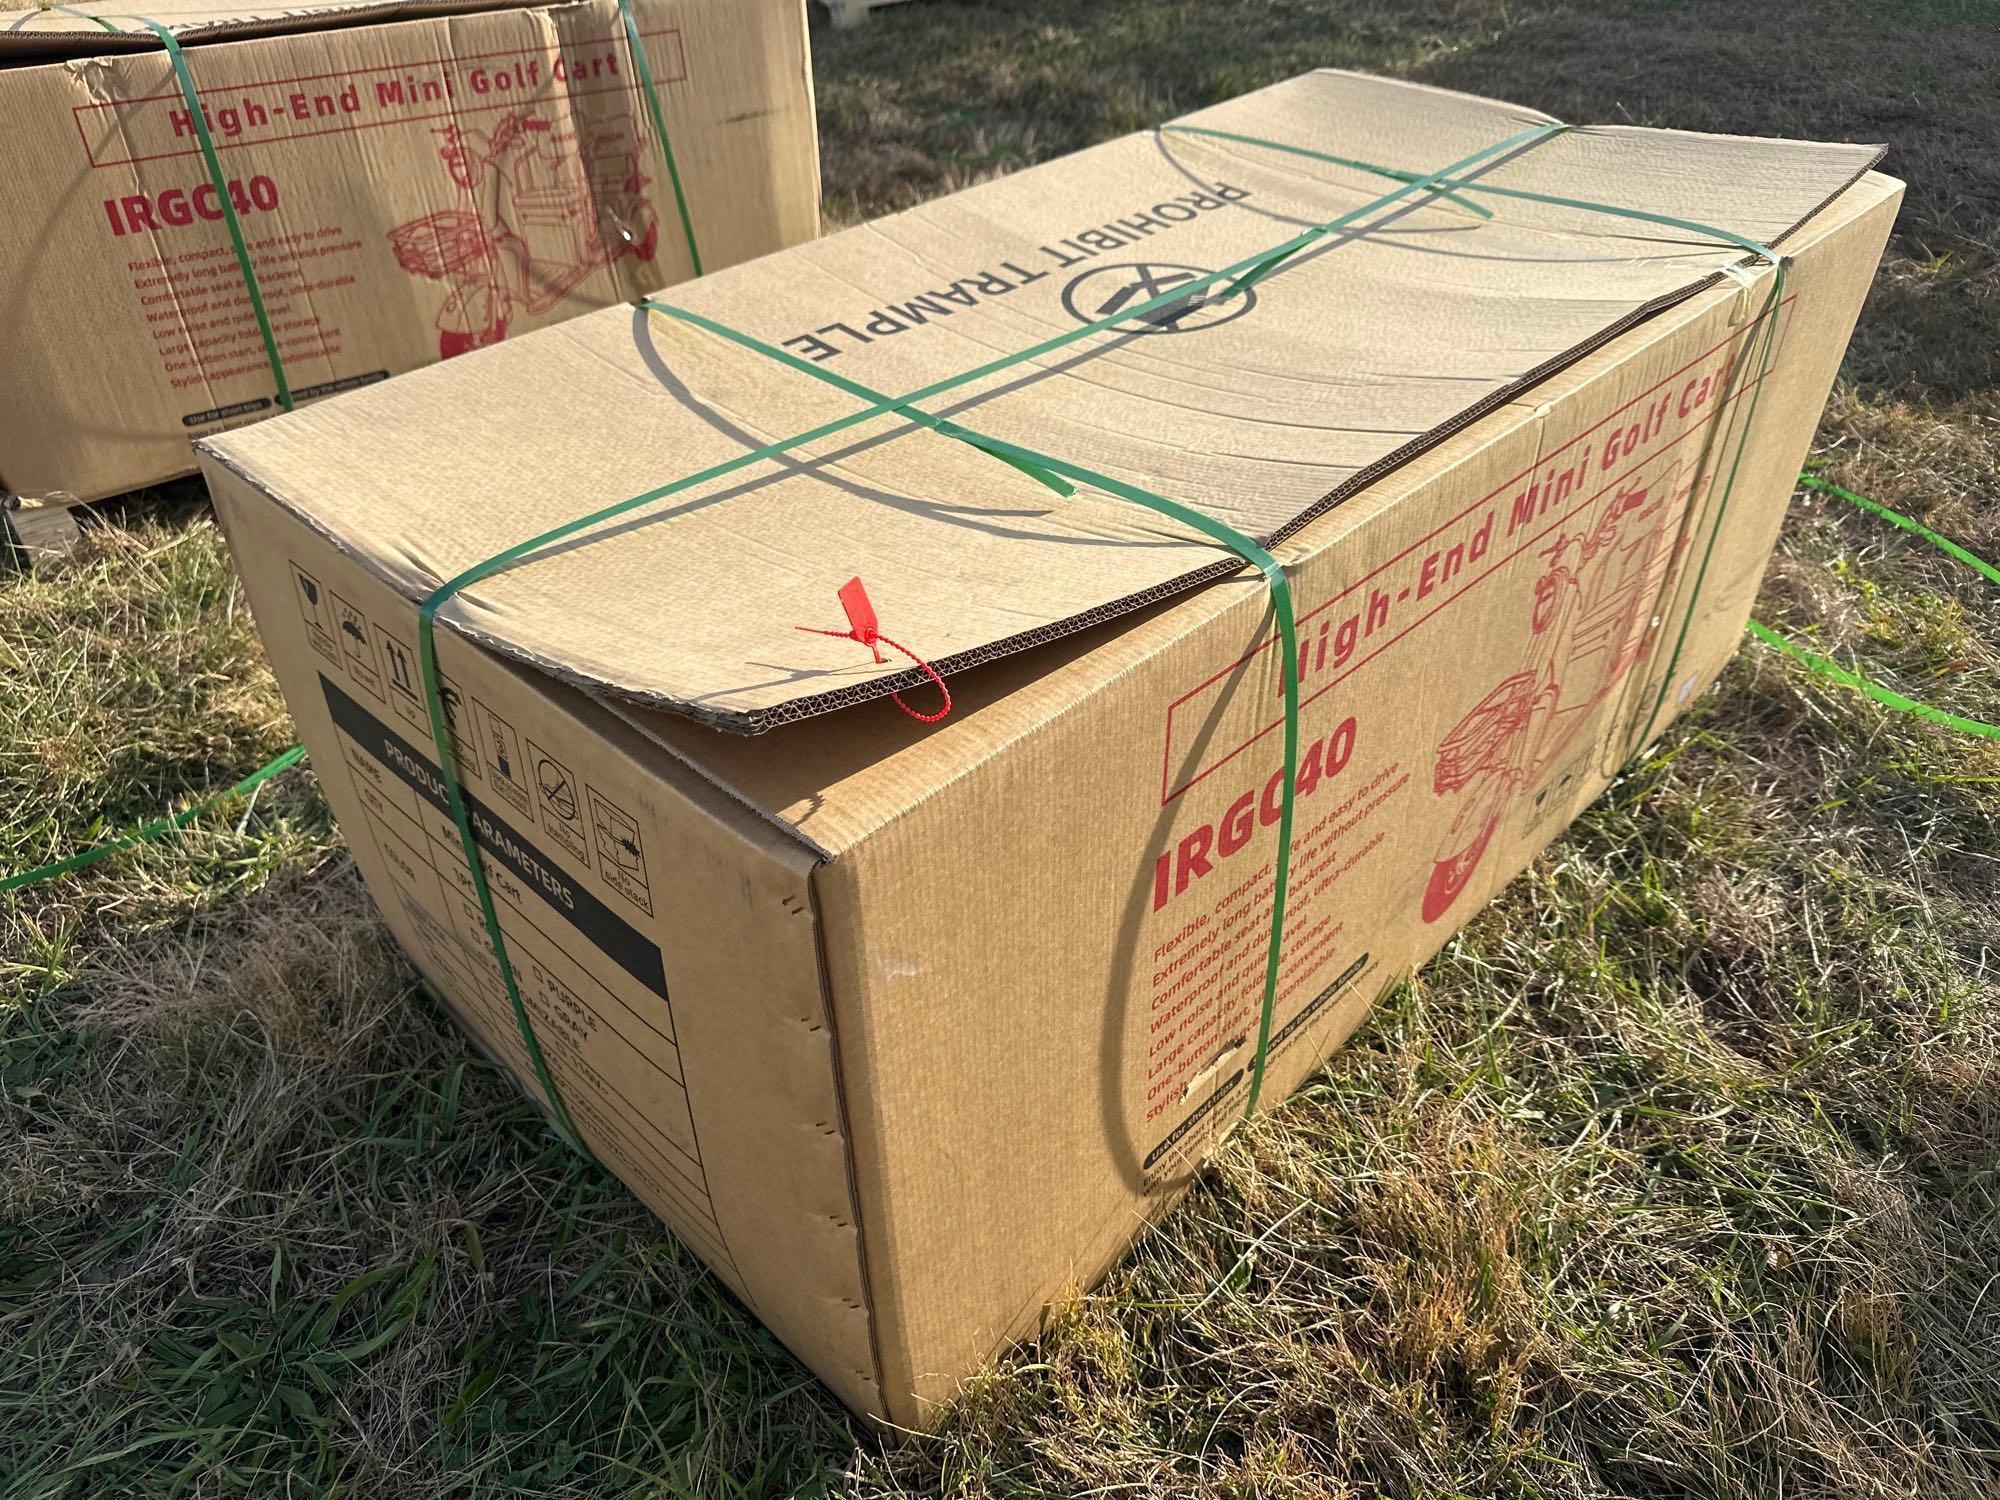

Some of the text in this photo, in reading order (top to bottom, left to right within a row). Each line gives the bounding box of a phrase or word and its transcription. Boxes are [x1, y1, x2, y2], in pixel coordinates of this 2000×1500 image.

[169, 53, 620, 138] High-End Mini Golf Cart
[103, 175, 279, 236] IRGC40
[256, 238, 275, 249] and
[304, 232, 314, 240] to
[317, 227, 342, 237] drive
[192, 266, 217, 279] long
[211, 280, 232, 292] seat
[781, 182, 1252, 362] PROHIBIT TRAMPLE
[153, 329, 175, 339] Low
[210, 316, 230, 328] and
[211, 296, 231, 309] and
[1507, 444, 1591, 538] Mini
[1602, 391, 1671, 471] Golf
[1678, 352, 1736, 419] Cart
[351, 748, 383, 784] NAME
[384, 739, 450, 804] PRODUC
[1153, 716, 1357, 913] IRGC40
[452, 866, 477, 897] 1PC
[496, 872, 523, 904] Cart
[604, 870, 650, 911] side stack
[617, 869, 631, 887] No
[1152, 927, 1219, 988] Extremely
[1223, 902, 1251, 932] long
[1299, 848, 1318, 868] life
[1320, 811, 1364, 852] without
[1364, 772, 1410, 819] pressure
[1154, 914, 1210, 963] Flexible,
[1215, 863, 1272, 914] compact,
[1303, 814, 1327, 845] and
[1328, 795, 1354, 825] easy
[1356, 784, 1368, 800] to
[1370, 762, 1398, 793] drive
[1151, 938, 1231, 1011] Comfortable
[1234, 914, 1260, 944] seat
[1288, 852, 1337, 899] backrest
[1151, 963, 1224, 1034] Waterproof
[1226, 942, 1250, 971] and
[1314, 831, 1385, 897] ultra-durable
[547, 979, 598, 1033] PURPLE
[554, 1004, 588, 1042] GRAY
[1148, 1042, 1184, 1080] Large
[1187, 995, 1239, 1045] capacity
[1290, 914, 1331, 956] storage
[1149, 1028, 1176, 1058] Low
[1179, 998, 1214, 1032] noise
[1215, 972, 1240, 1000] and
[1284, 1023, 1297, 1036] by
[1296, 1008, 1311, 1025] the
[1147, 1034, 1218, 1101] One-button
[1221, 1006, 1251, 1036] start,
[1146, 1080, 1188, 1123] Stylish
[1152, 1141, 1172, 1160] Use
[1171, 1126, 1187, 1145] for
[1187, 1102, 1212, 1125] short
[1212, 1081, 1234, 1102] trips
